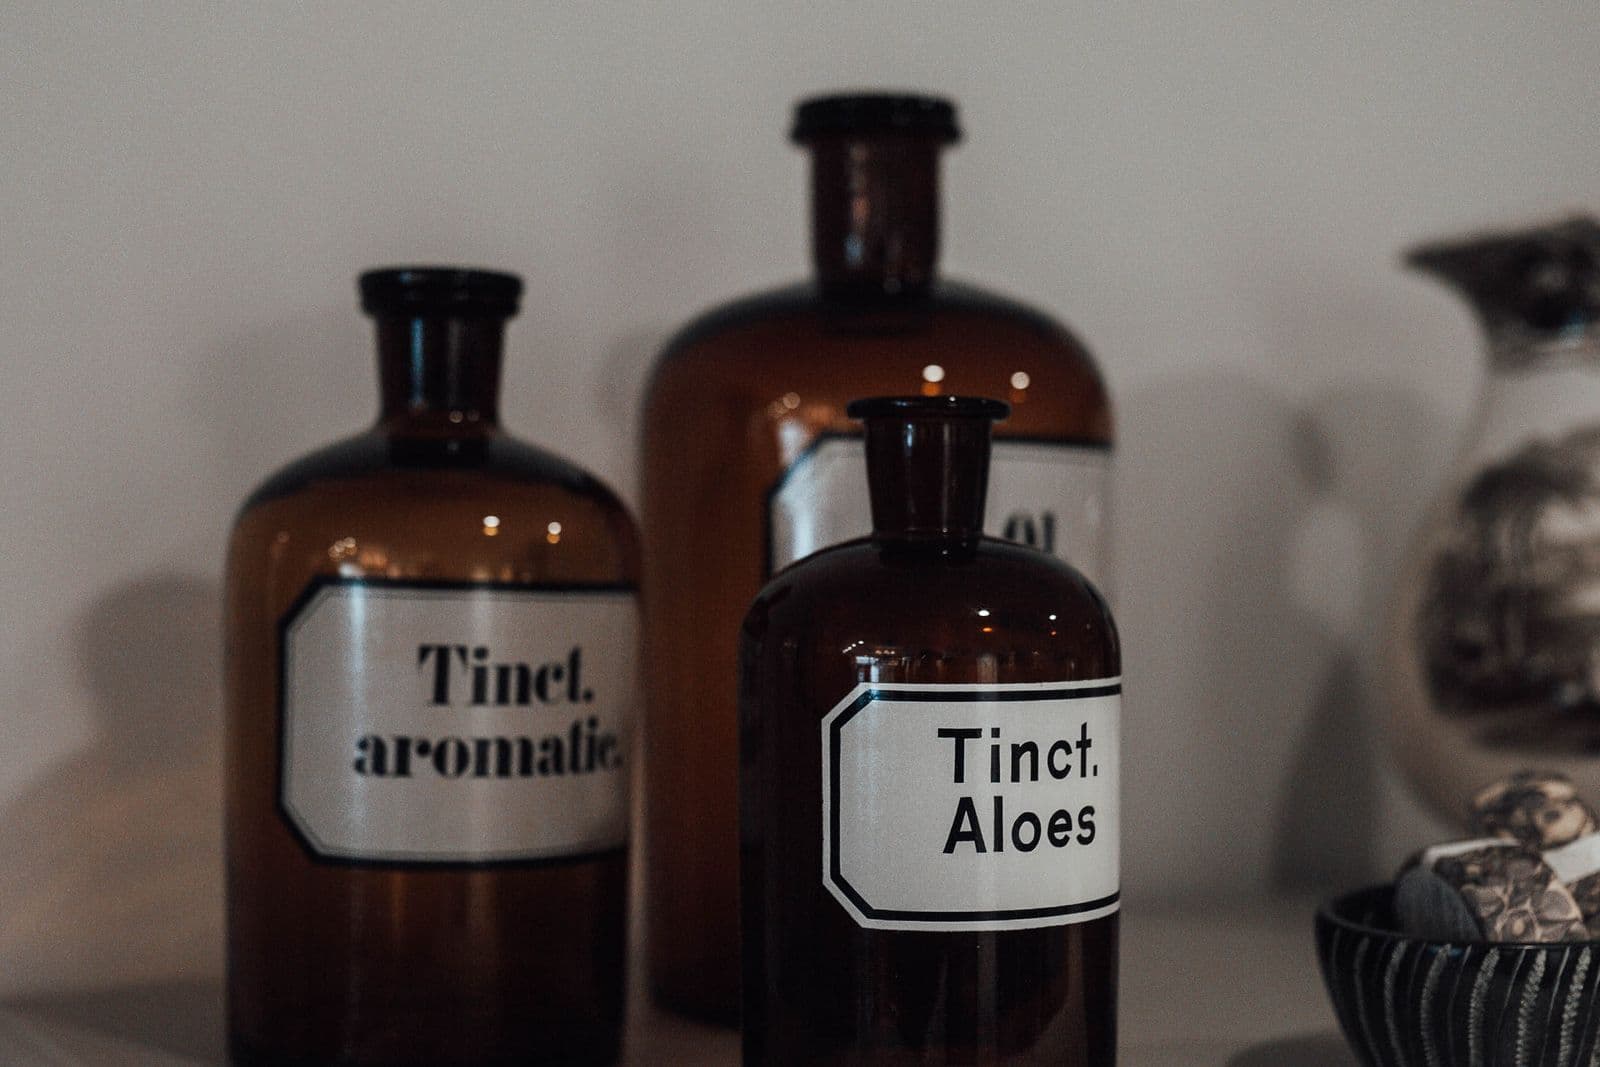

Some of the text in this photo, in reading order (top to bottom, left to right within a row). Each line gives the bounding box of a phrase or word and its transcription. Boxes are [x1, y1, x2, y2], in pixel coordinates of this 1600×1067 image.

[417, 643, 594, 706] Tinct.
[937, 722, 1098, 783] Tinct.
[942, 795, 1096, 854] Aloes
